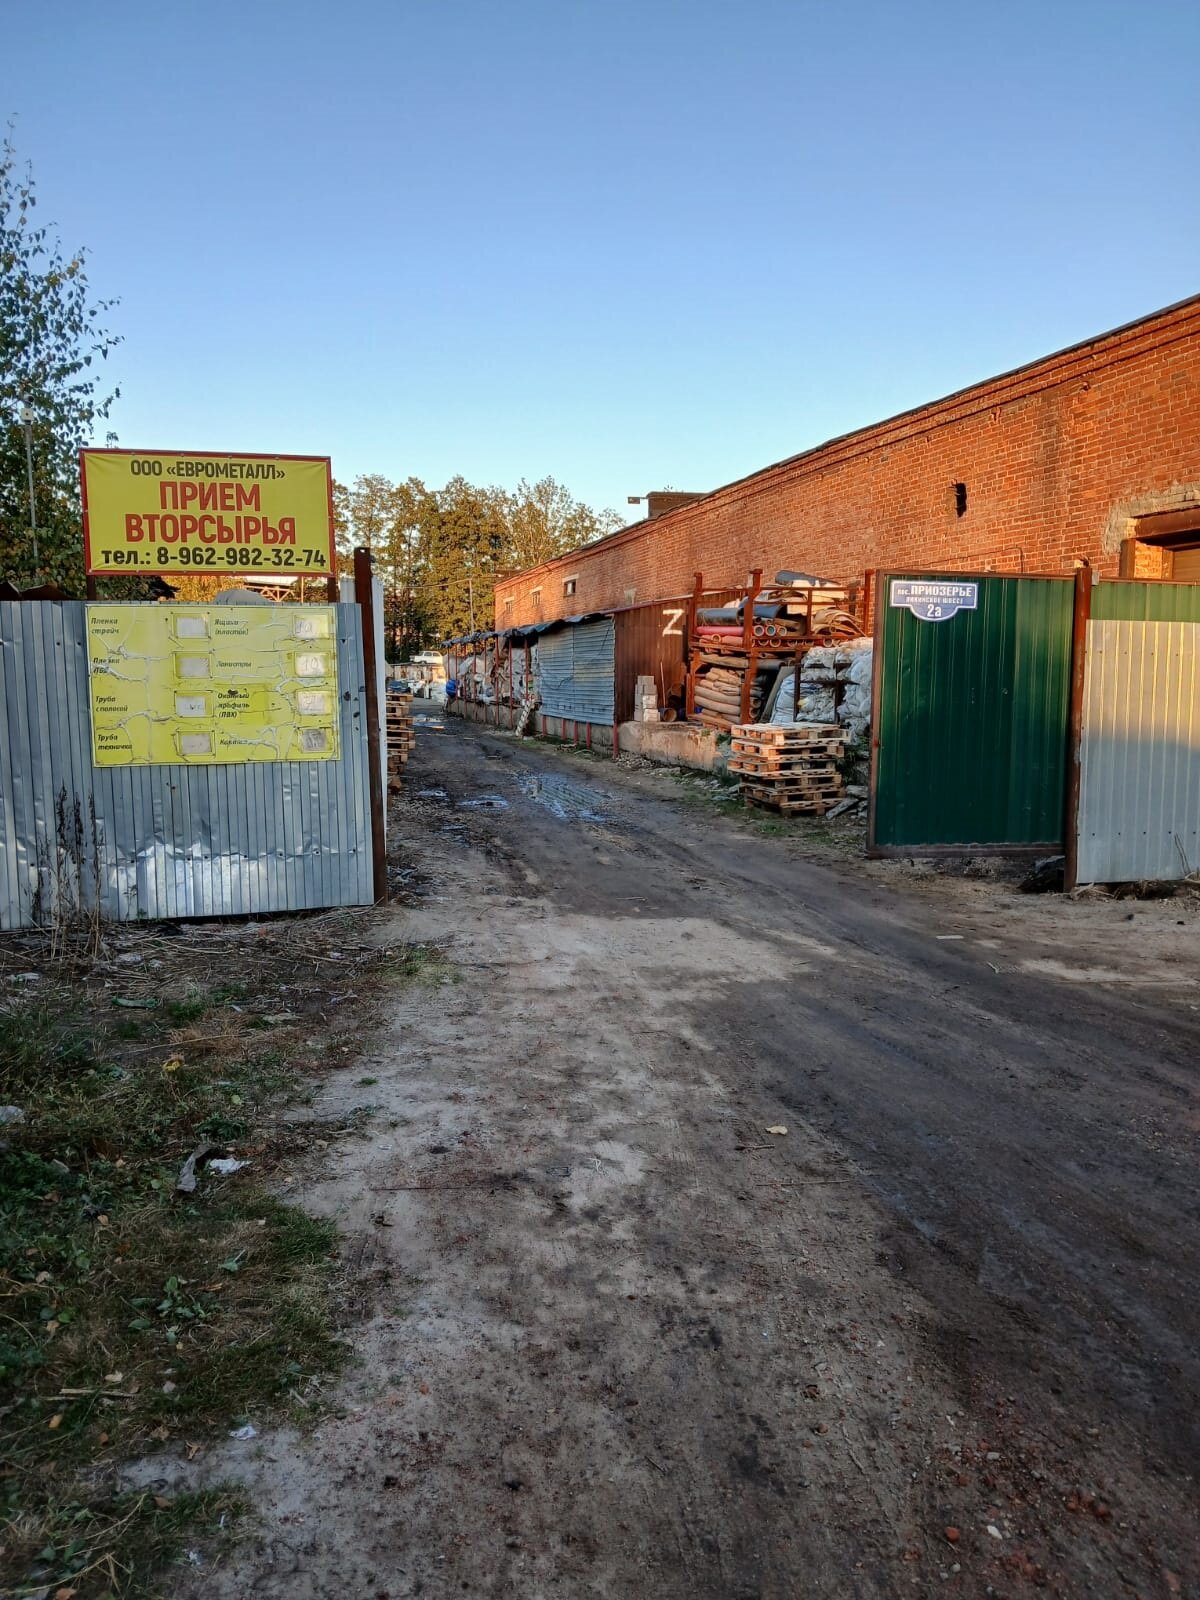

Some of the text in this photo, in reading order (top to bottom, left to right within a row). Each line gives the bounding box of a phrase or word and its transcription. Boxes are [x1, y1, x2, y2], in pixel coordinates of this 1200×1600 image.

[130, 459, 286, 480] ООО «ЕВРОМЕТАЛЛ»
[159, 481, 261, 512] ПРИЕМ
[125, 513, 296, 545] ВТОРСЫРЬЯ
[101, 547, 326, 567] тел.: 8-962-982-32-74
[911, 585, 973, 597] ПРИОЗЕРЬЕ
[927, 604, 942, 617] 2а
[662, 608, 685, 637] Z
